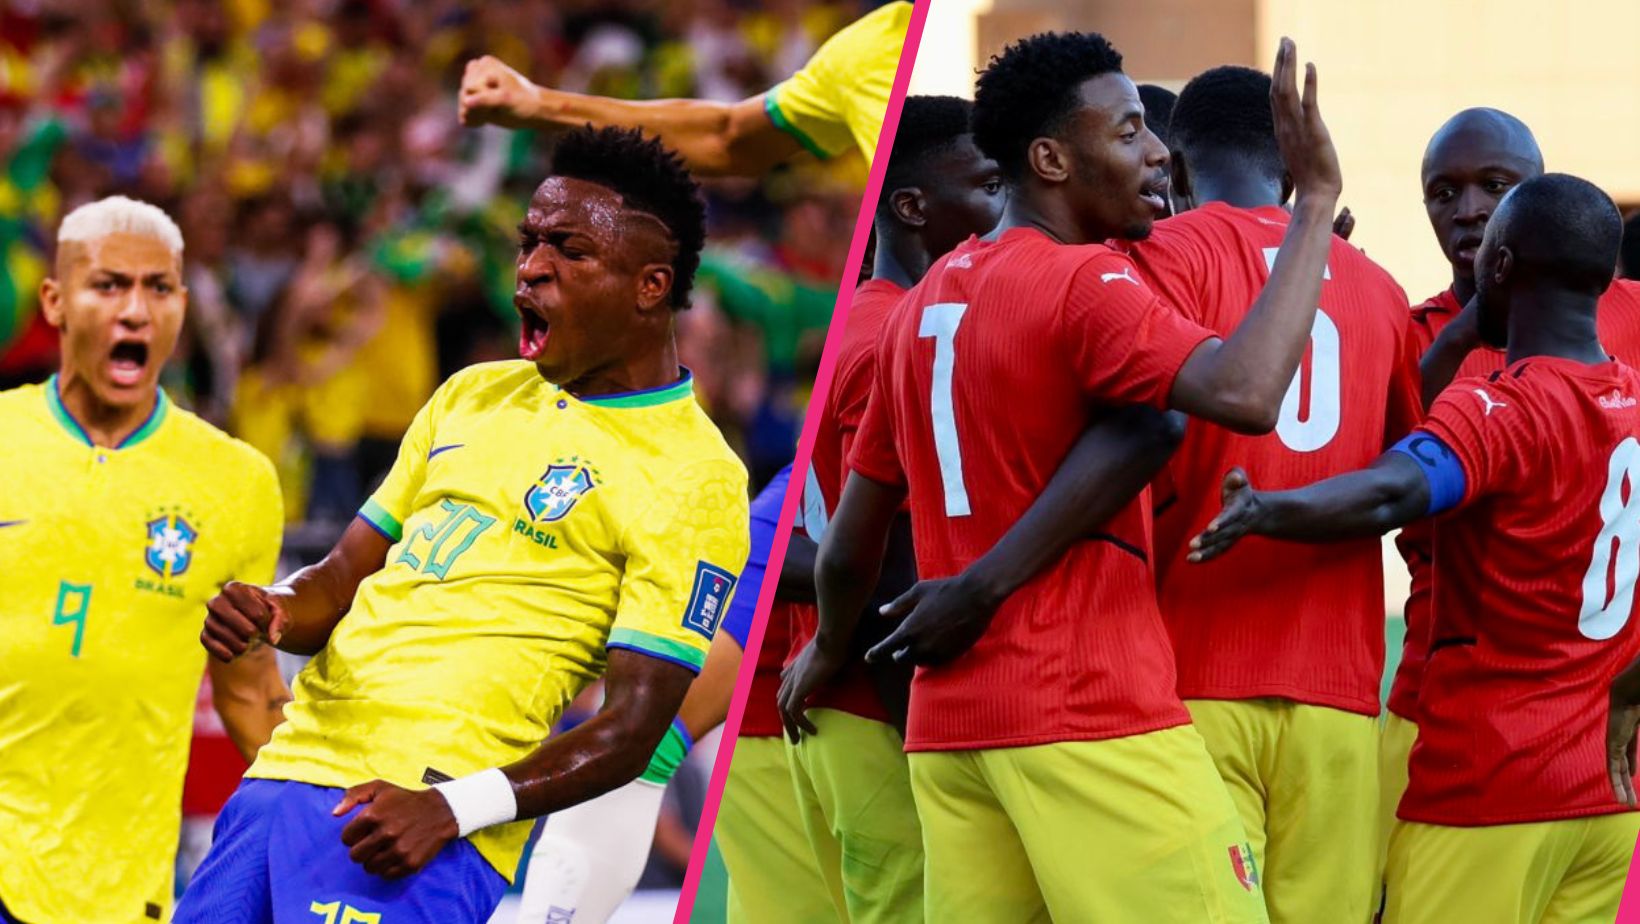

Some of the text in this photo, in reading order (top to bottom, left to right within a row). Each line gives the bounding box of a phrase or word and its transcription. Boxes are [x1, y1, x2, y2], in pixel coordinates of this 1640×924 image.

[917, 302, 972, 517] 1
[549, 485, 570, 498] CBF
[1408, 436, 1449, 468] C
[394, 497, 497, 582] 20
[512, 517, 558, 549] RASIL
[1577, 436, 1640, 641] 8
[52, 579, 93, 659] 9
